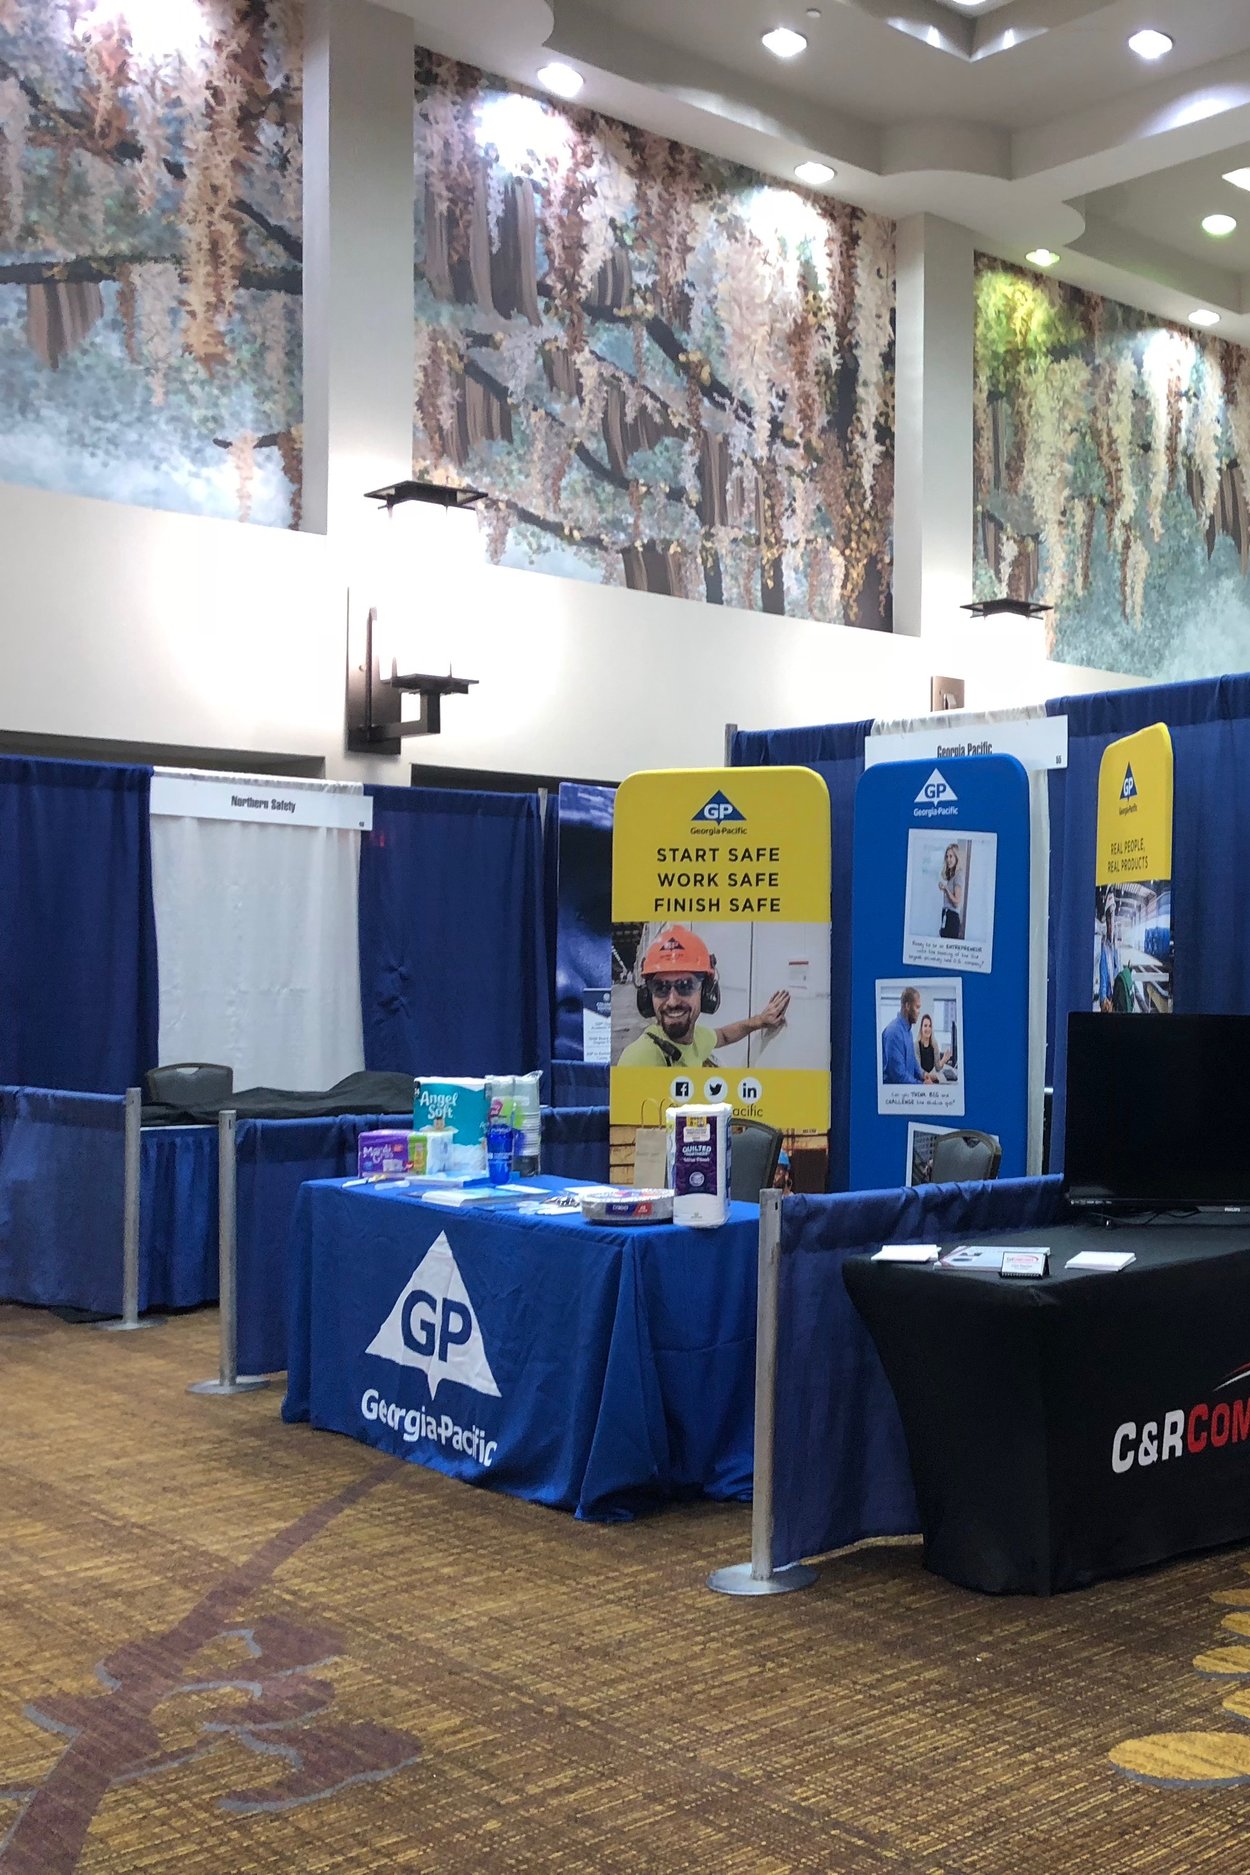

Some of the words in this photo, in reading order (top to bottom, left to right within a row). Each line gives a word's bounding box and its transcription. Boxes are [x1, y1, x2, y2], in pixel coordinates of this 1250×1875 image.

[967, 741, 993, 756] Pacific
[924, 783, 947, 798] GP
[1123, 777, 1134, 796] GP
[231, 795, 269, 809] Northern
[271, 799, 296, 813] Safety
[703, 803, 733, 819] GP
[657, 847, 720, 862] START
[728, 847, 780, 862] SAFE
[1110, 842, 1123, 856] REAL
[1124, 838, 1146, 854] PEOPLE,
[1107, 860, 1120, 873] REAL
[1121, 856, 1149, 872] PRODUCTS
[657, 872, 719, 887] WORK
[728, 872, 779, 887] SAFE
[654, 897, 720, 912] FINISH
[729, 897, 781, 912] SAFE
[420, 1091, 459, 1106] Angel
[428, 1105, 454, 1119] Soft
[682, 1145, 712, 1154] QUILTED
[401, 1289, 473, 1363] GP
